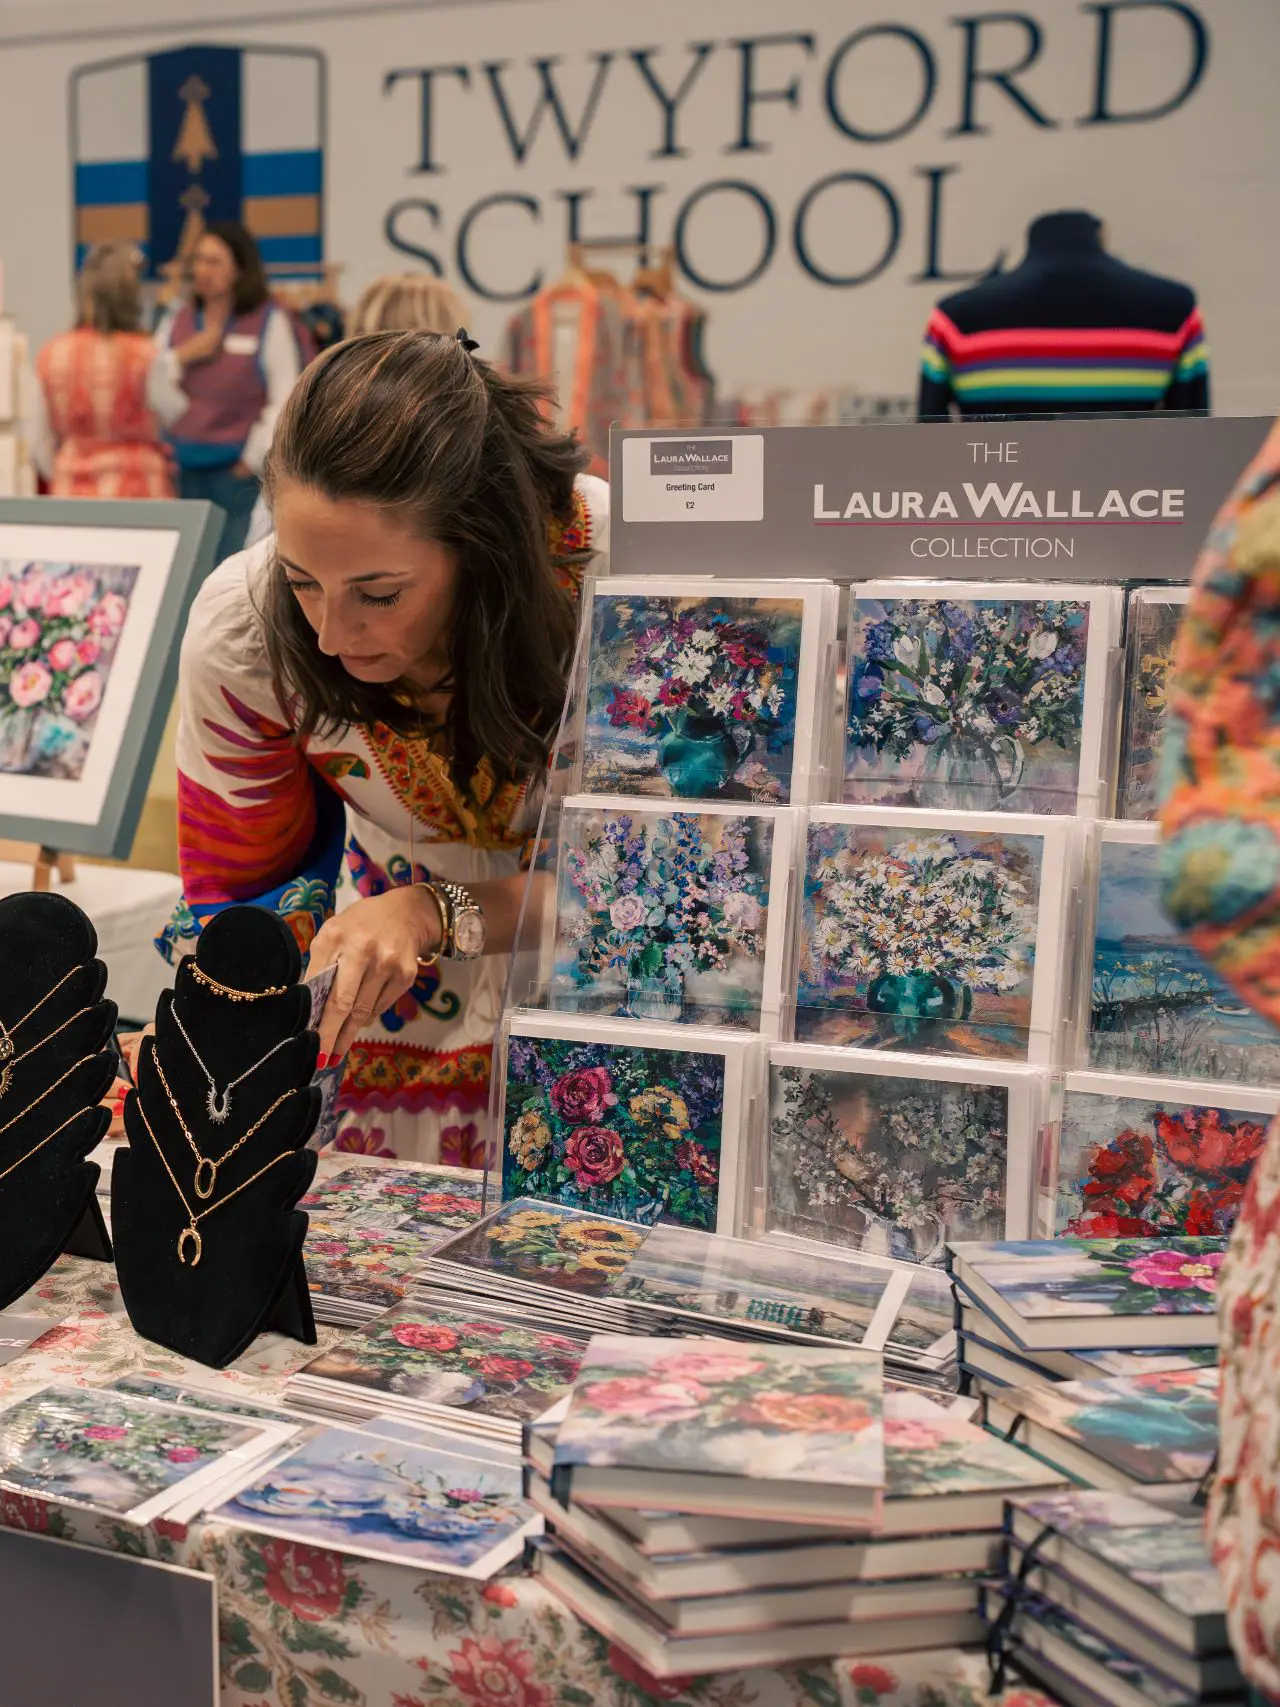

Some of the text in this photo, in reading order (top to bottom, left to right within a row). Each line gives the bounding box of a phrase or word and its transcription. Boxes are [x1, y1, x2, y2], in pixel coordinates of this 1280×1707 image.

[382, 0, 1211, 178] TWYFORD
[382, 162, 1008, 306] SCHOOL
[653, 453, 729, 464] LAURA WALLACE
[967, 442, 1018, 464] THE
[665, 482, 716, 493] Greeting Card
[685, 501, 695, 509] £2
[813, 482, 1185, 519] LAURA WALLACE
[910, 537, 1074, 559] COLLECTION
